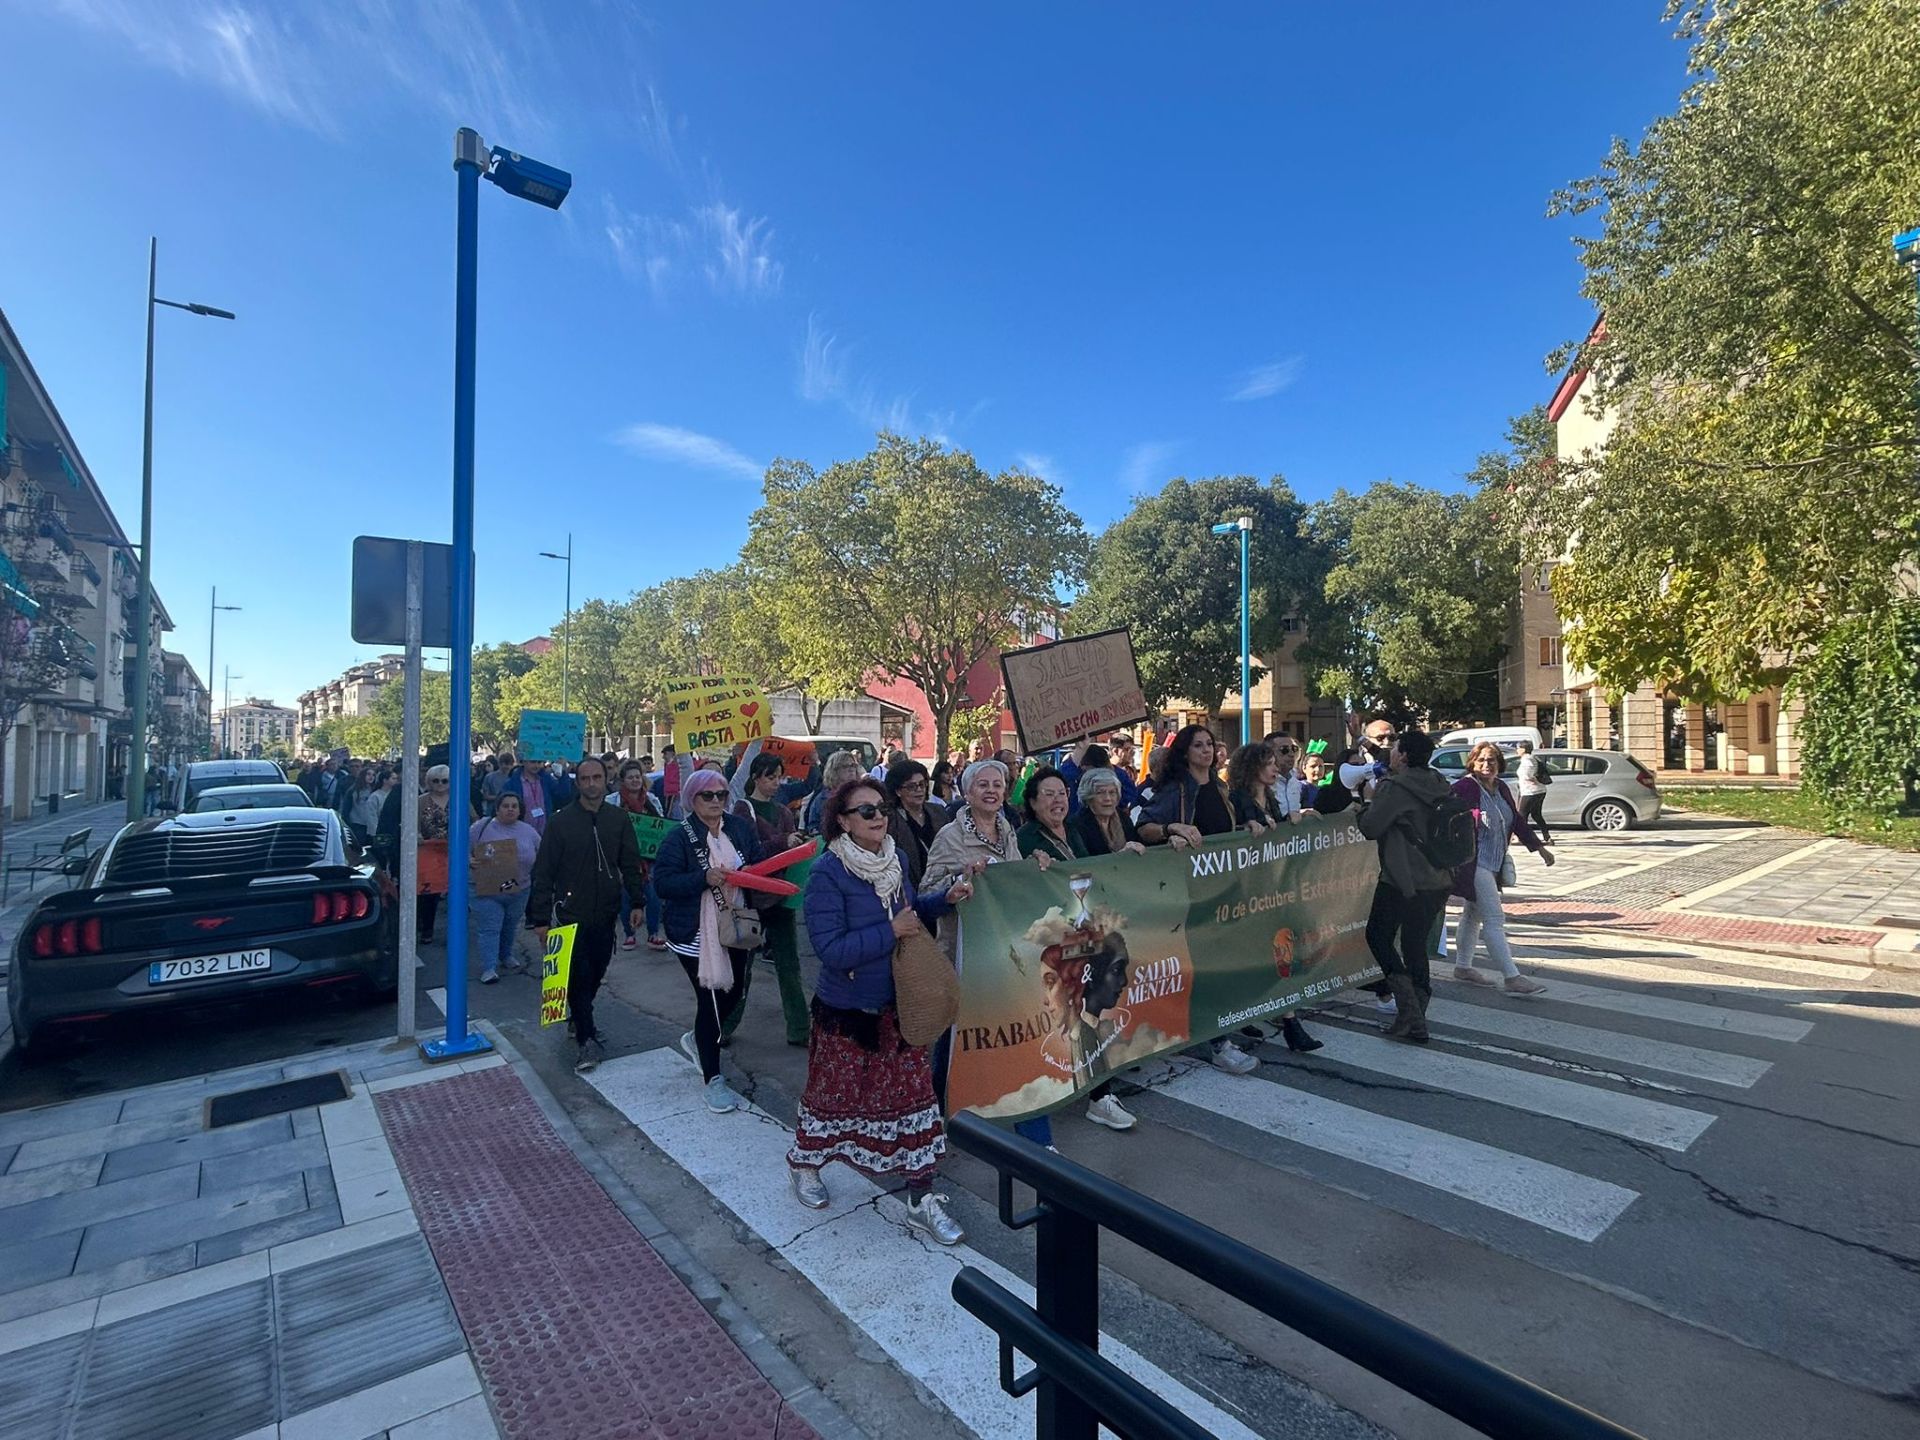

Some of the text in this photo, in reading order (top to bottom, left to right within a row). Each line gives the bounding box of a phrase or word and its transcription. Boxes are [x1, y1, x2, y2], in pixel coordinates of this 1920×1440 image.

[1030, 640, 1108, 688] SALUD
[674, 700, 690, 713] HOY
[694, 698, 701, 708] Y
[1021, 669, 1123, 725] MENTAL
[687, 719, 762, 750] BASTA YA
[694, 716, 702, 726] 7
[1054, 710, 1100, 738] DERECHO
[1190, 850, 1233, 878] XXVI
[1237, 846, 1259, 870] Día
[1262, 833, 1312, 863] Mundial
[1314, 832, 1331, 850] de
[1333, 828, 1345, 847] la
[1215, 904, 1230, 923] 10
[1232, 903, 1246, 918] de
[1249, 890, 1296, 913] Octubre
[165, 951, 265, 979] 7032 LNC
[1081, 963, 1093, 984] &
[1133, 956, 1181, 986] SALUD
[1126, 975, 1184, 1007] MENTAL
[1217, 992, 1301, 1029] feafesextremadura.com
[1304, 985, 1317, 998] 682
[1317, 980, 1330, 994] 632
[1331, 975, 1344, 988] 100
[957, 1010, 1051, 1052] TRABAJO
